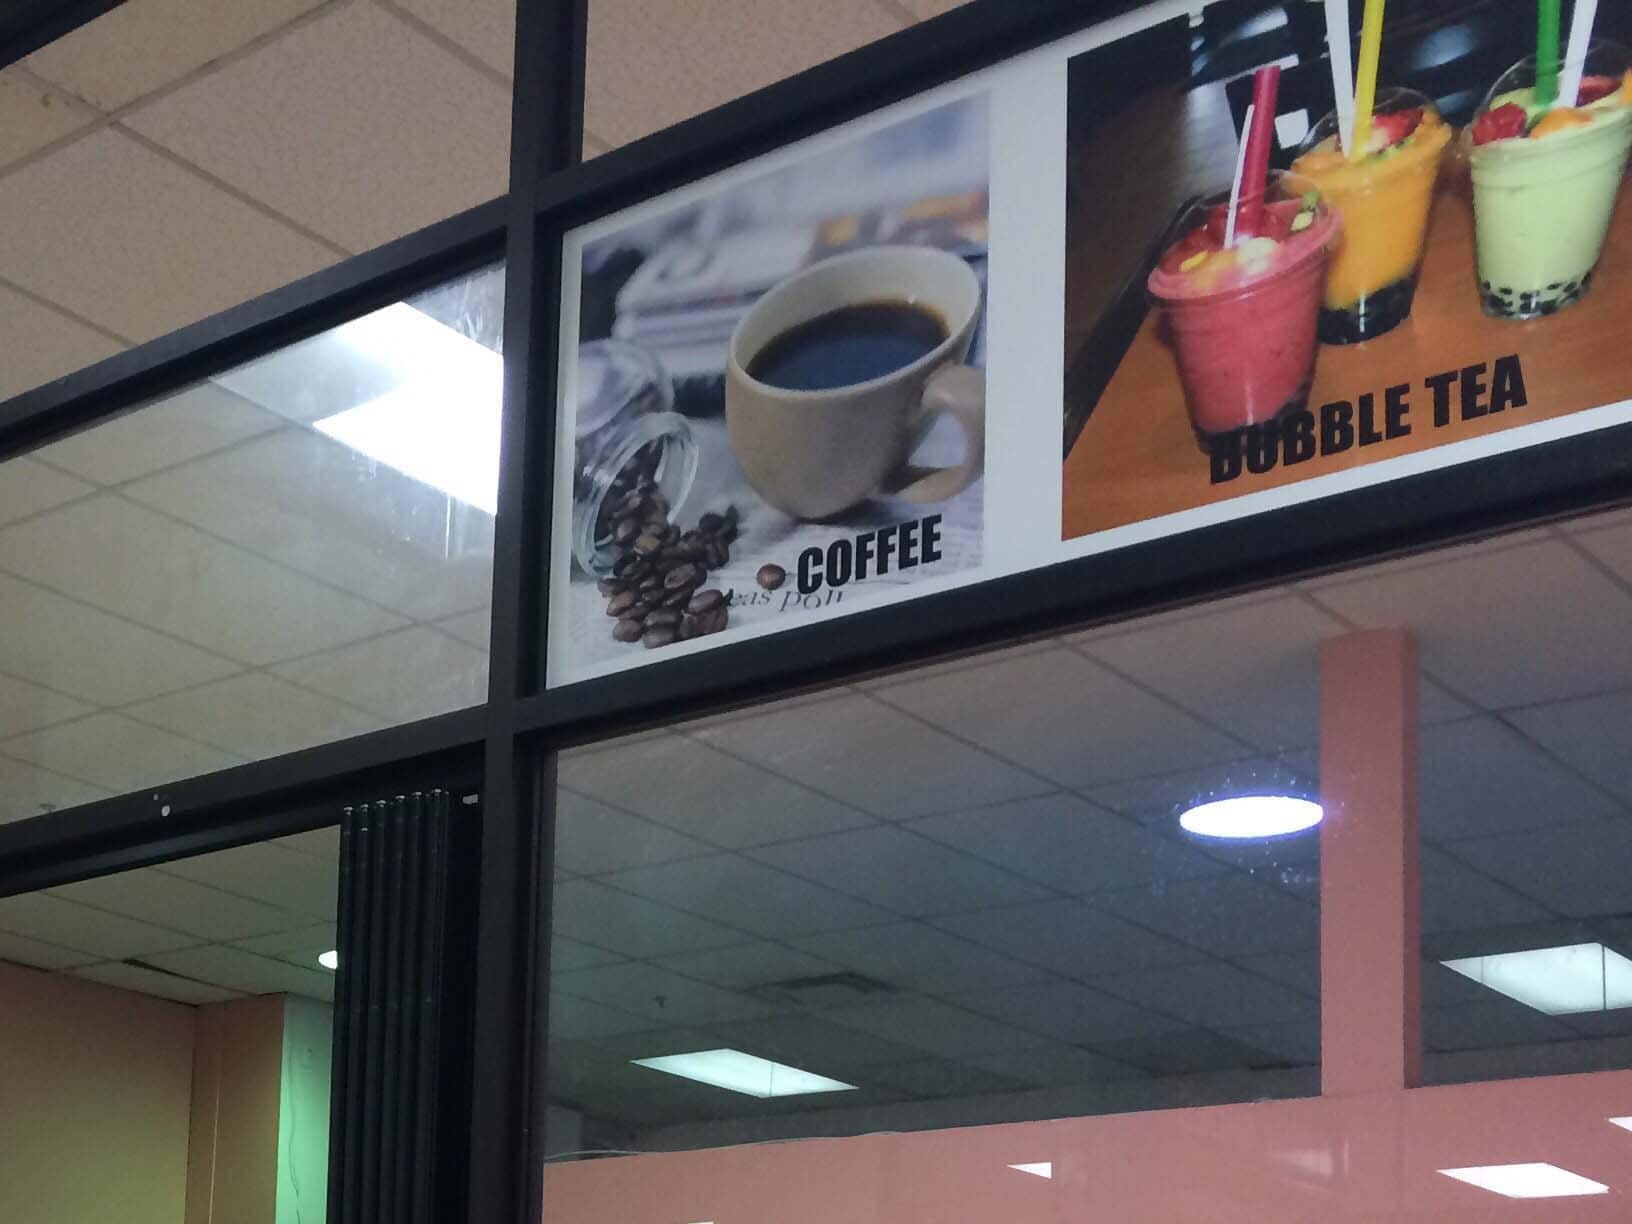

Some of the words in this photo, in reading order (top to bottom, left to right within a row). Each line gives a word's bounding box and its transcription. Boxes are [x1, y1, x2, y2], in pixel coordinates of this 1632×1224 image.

[1209, 390, 1412, 487] BUBBLE
[1423, 353, 1528, 423] TEA
[797, 513, 943, 595] COFFEE
